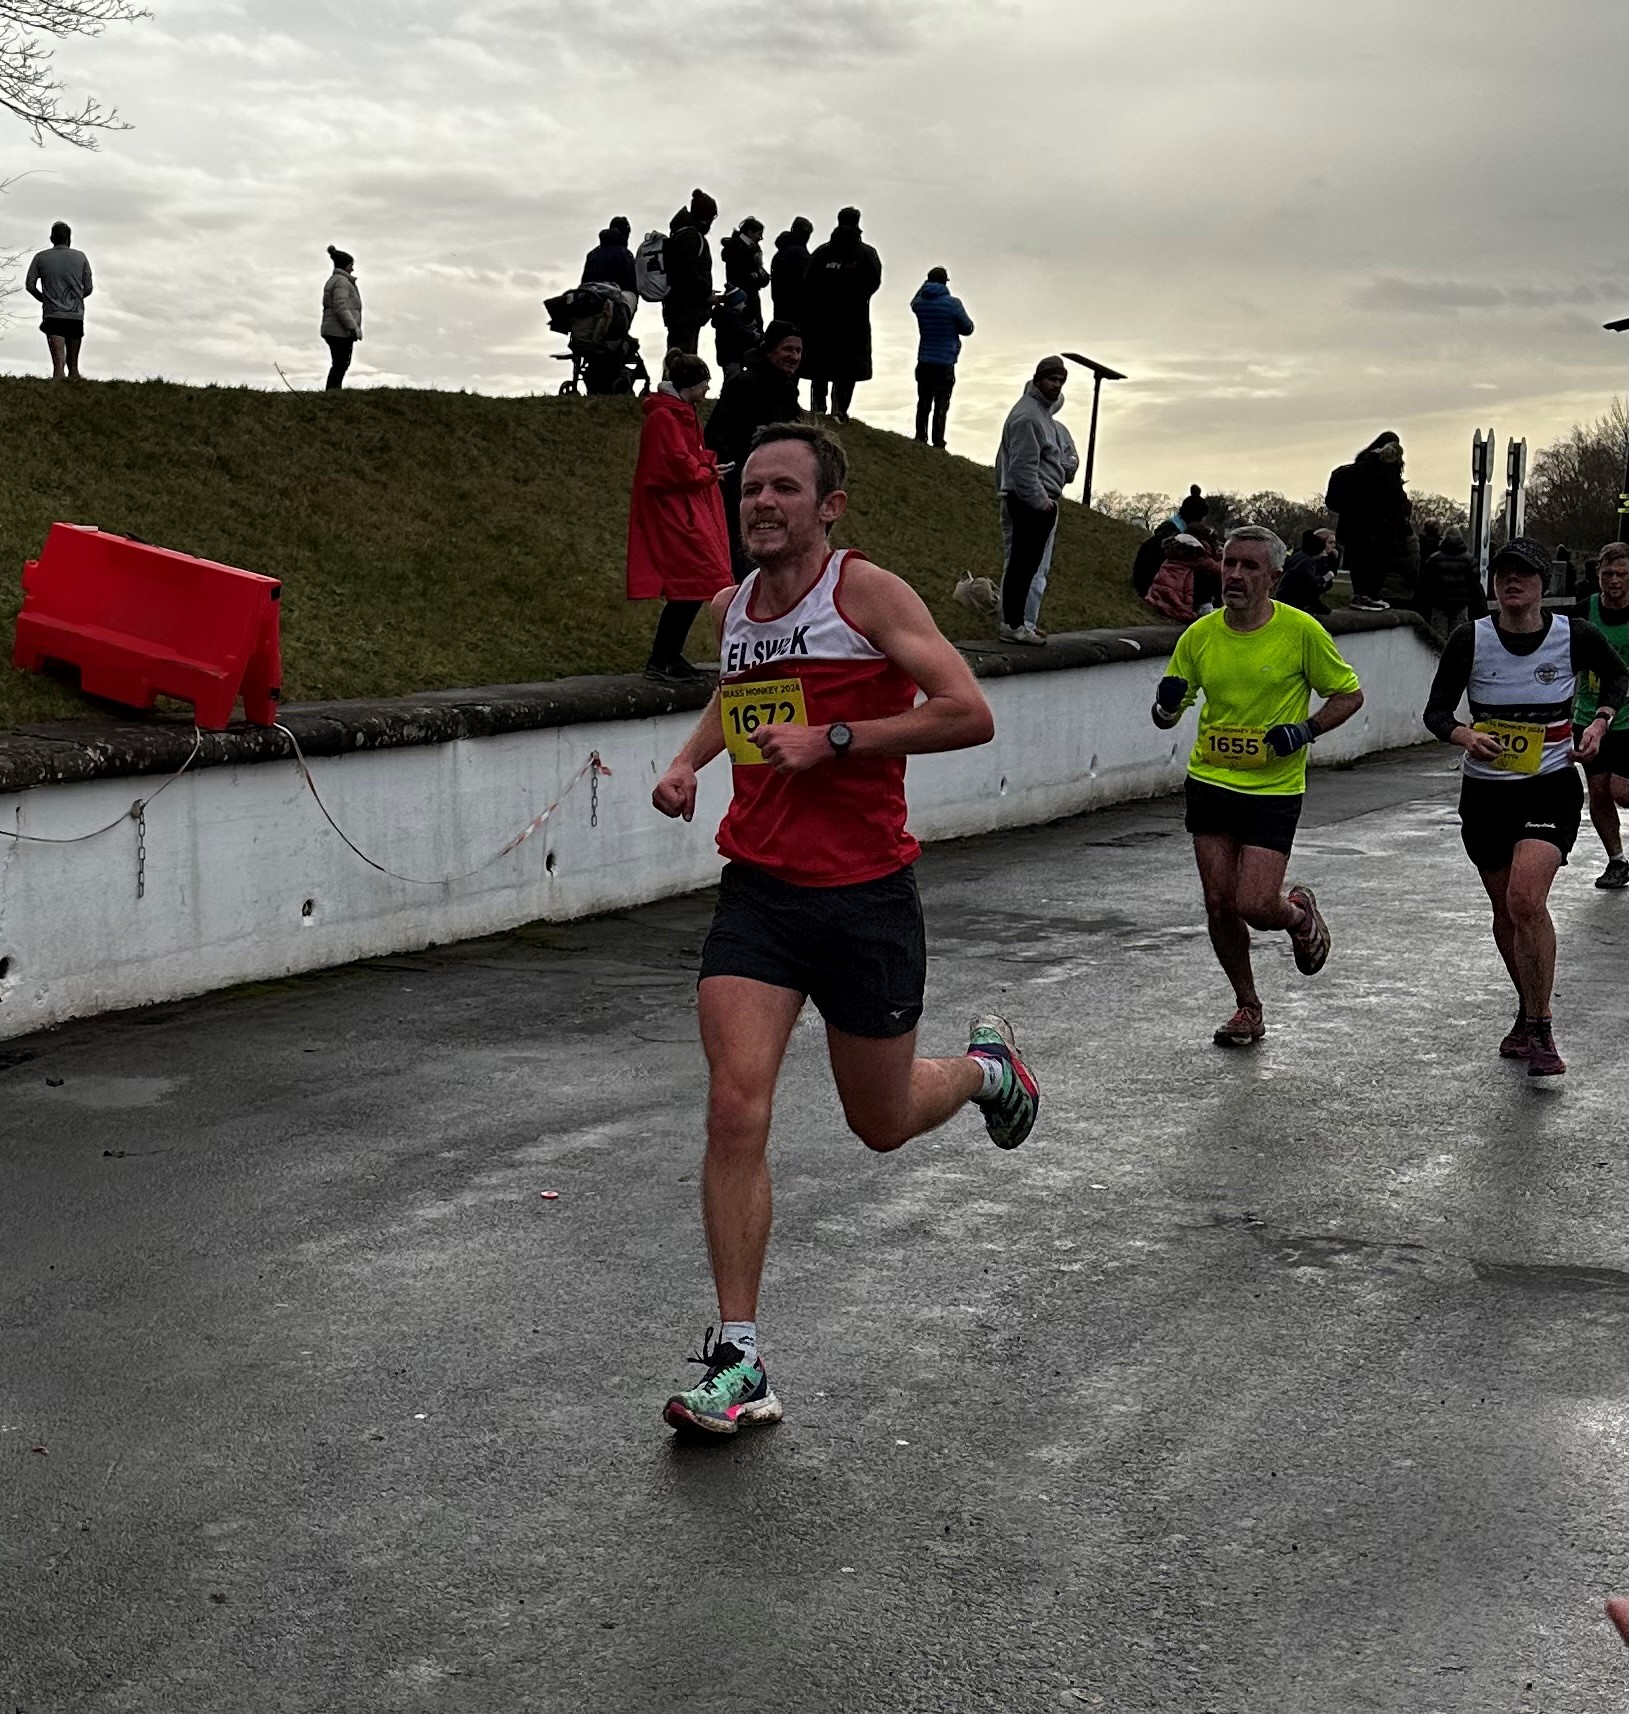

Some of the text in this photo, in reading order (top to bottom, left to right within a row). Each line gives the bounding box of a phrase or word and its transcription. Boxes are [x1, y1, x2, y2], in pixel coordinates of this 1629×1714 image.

[746, 685, 778, 697] MONKEY
[780, 683, 800, 694] 2024
[729, 701, 795, 735] 1672
[1209, 735, 1260, 756] 1655
